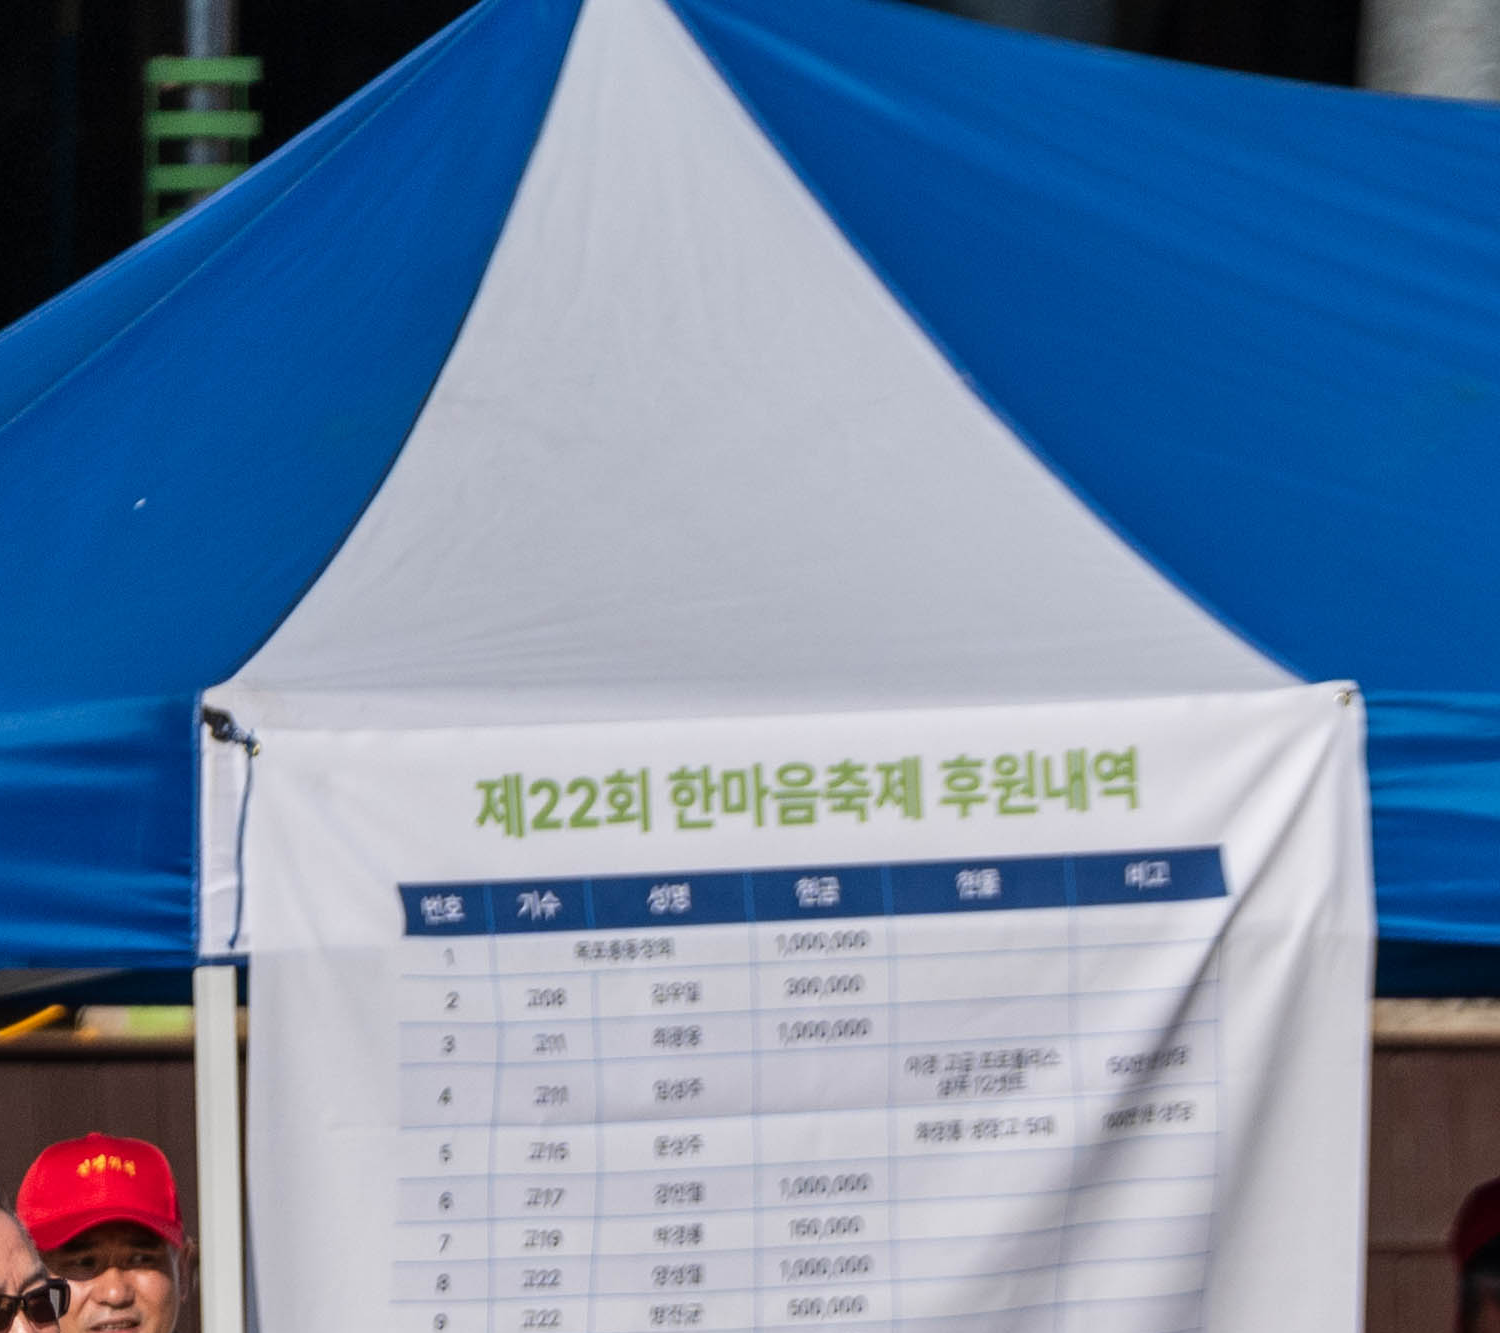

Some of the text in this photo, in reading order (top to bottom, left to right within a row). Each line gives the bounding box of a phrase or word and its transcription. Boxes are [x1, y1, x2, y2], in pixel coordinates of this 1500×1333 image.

[475, 747, 1140, 838] 제22회 한마음축제 후원내역
[421, 895, 465, 923] 번호
[517, 891, 562, 920] 기수
[647, 883, 690, 914] 성명
